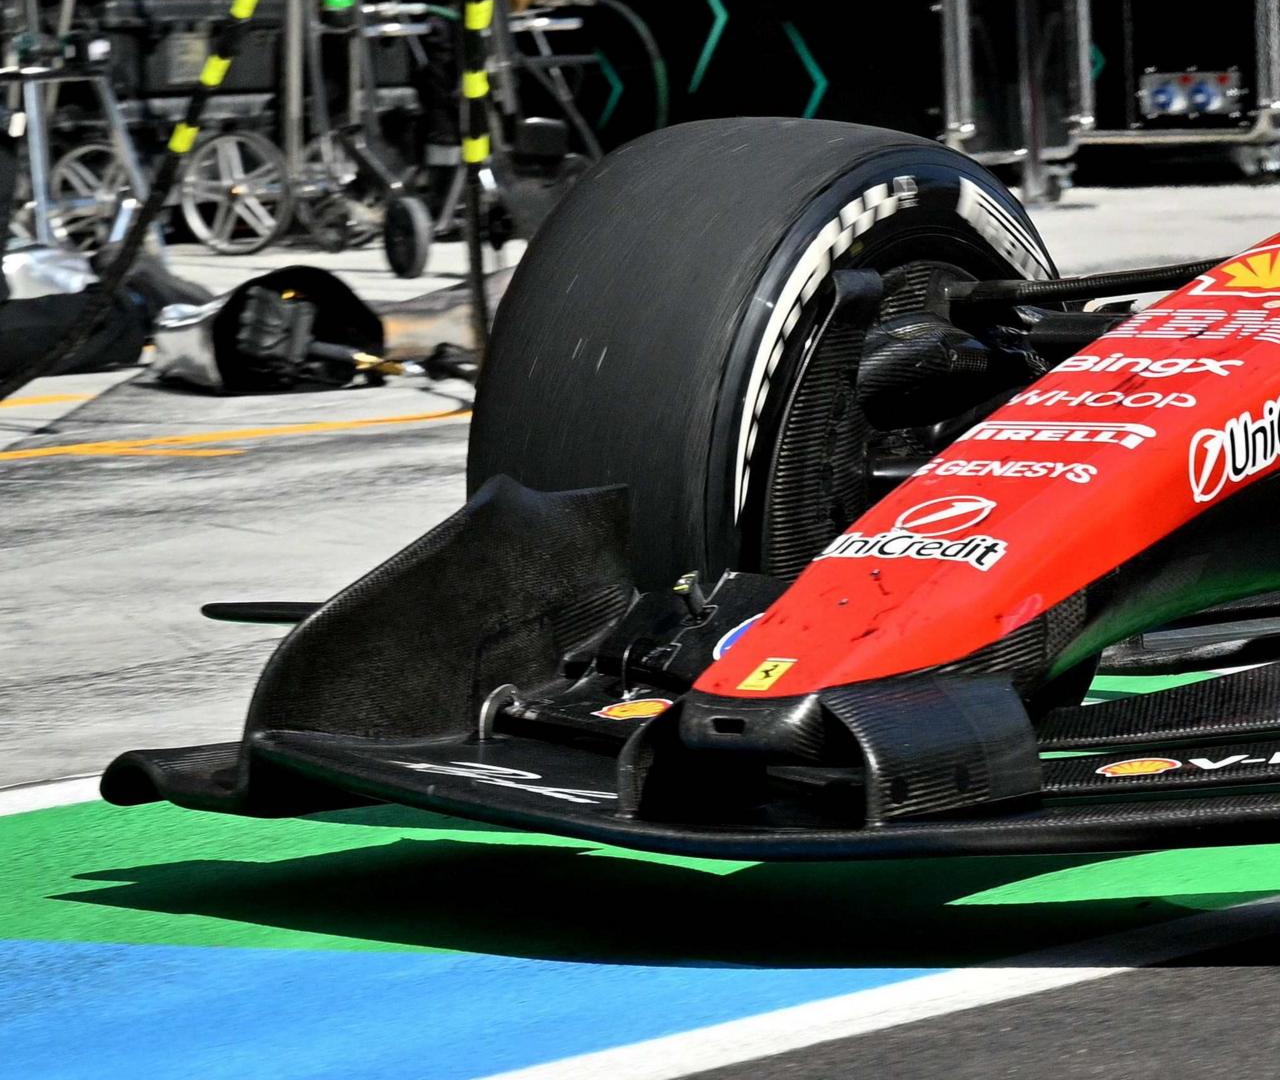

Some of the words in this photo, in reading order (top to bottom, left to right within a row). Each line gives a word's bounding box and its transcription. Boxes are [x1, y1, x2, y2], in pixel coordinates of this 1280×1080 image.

[1006, 389, 1197, 408] WHOOP
[954, 420, 1157, 449] PIRELLI
[935, 458, 1099, 484] GENESYS
